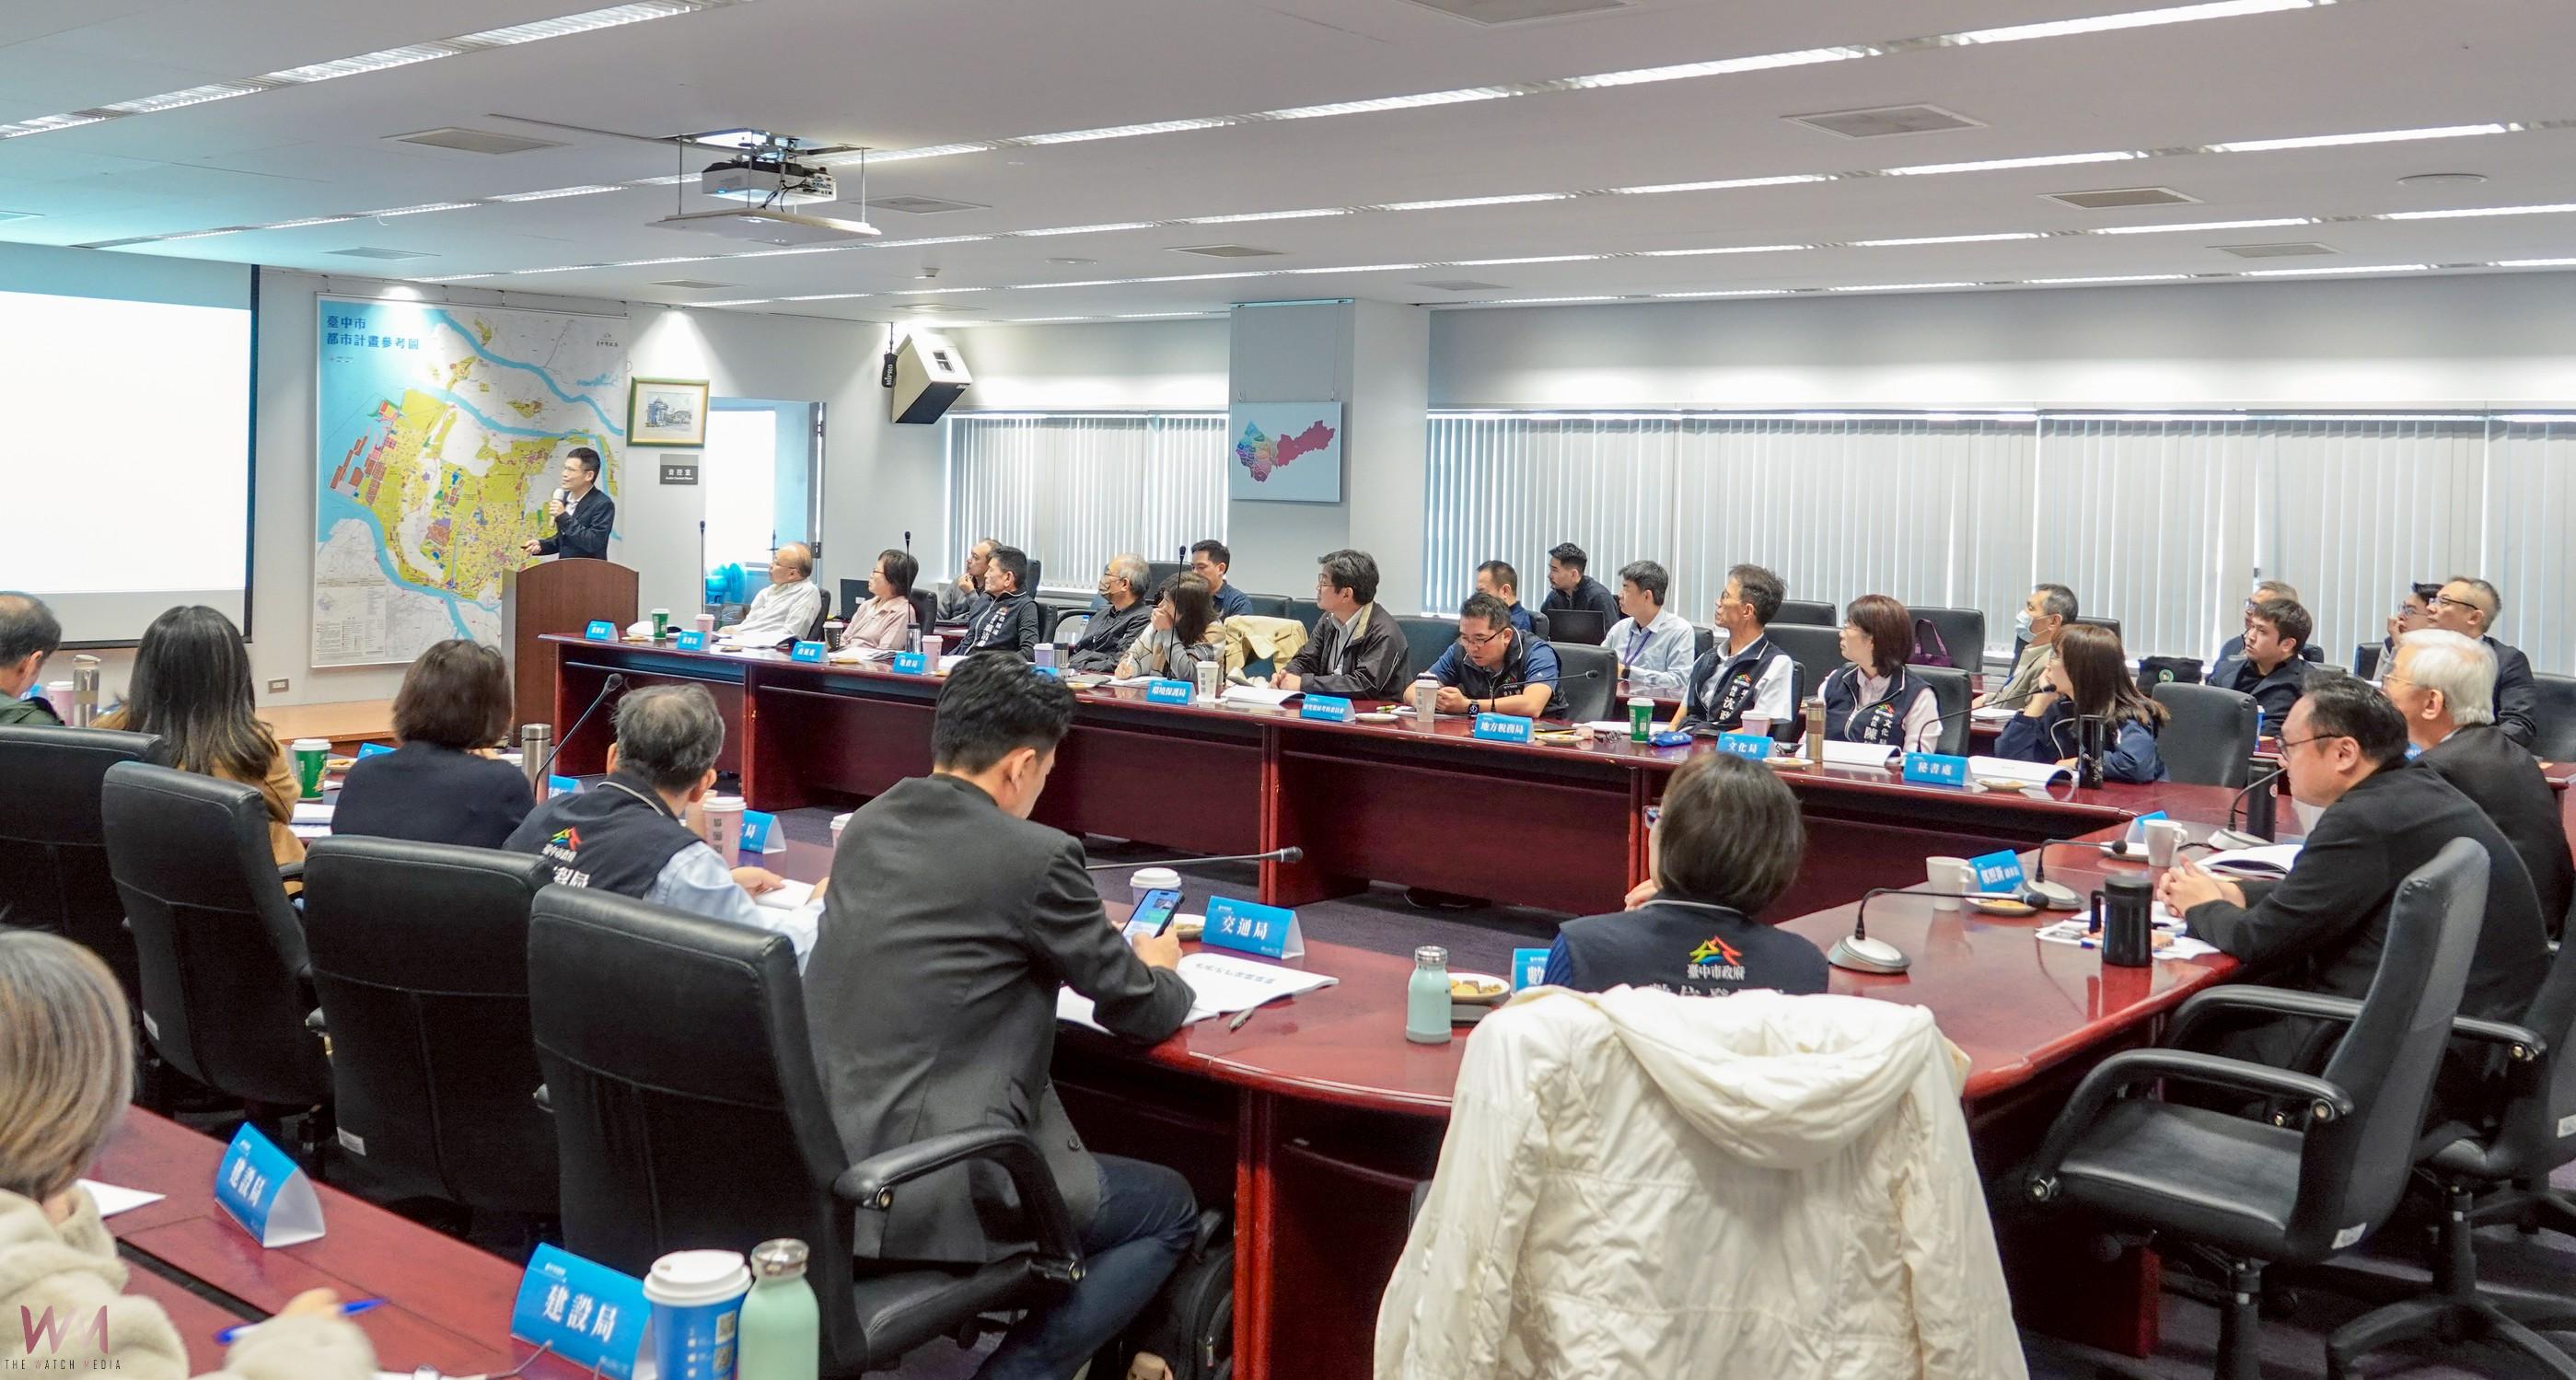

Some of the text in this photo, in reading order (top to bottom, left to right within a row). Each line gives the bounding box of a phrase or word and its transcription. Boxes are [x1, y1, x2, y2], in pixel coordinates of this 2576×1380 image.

[327, 315, 366, 330] 臺中市
[1728, 741, 1758, 754] 文化局
[1220, 914, 1269, 941] 交通局
[1687, 963, 1746, 980] 臺中市政府
[541, 1283, 619, 1343] 建設局
